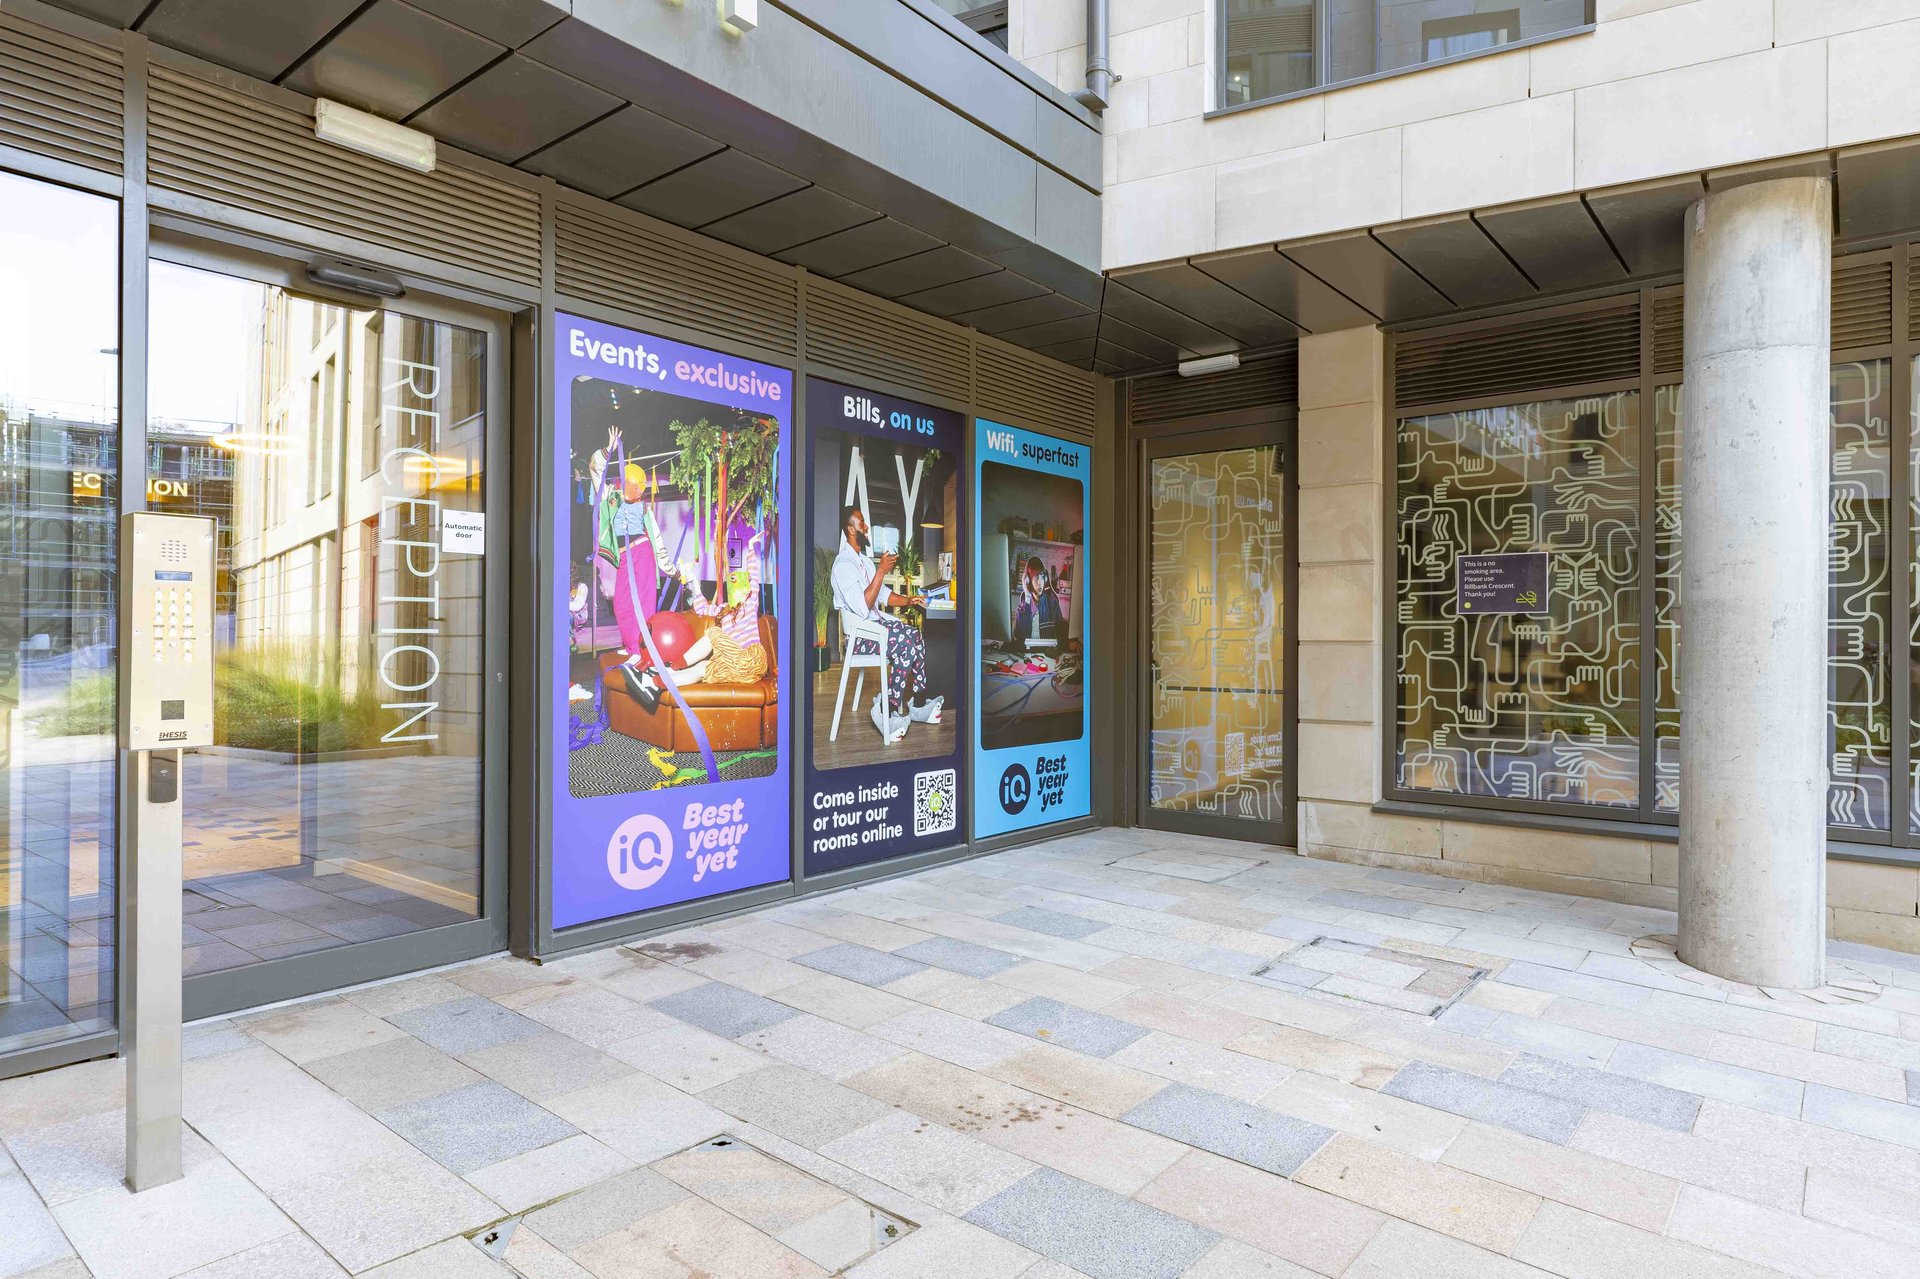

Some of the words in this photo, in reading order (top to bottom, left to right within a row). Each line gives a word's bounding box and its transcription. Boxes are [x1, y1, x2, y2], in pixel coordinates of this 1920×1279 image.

[570, 329, 667, 380] Events,
[674, 360, 781, 401] exclusive
[843, 395, 885, 429] Bills,
[890, 411, 911, 431] on
[916, 417, 935, 436] us
[986, 429, 1018, 458] Wifi,
[1022, 443, 1079, 468] superfast
[445, 522, 483, 532] Automatic
[381, 357, 440, 743] RECEPTION
[1036, 754, 1067, 775] Best
[813, 792, 855, 810] Come
[858, 781, 899, 803] inside
[1037, 773, 1068, 796] year
[1041, 788, 1064, 812] yet
[683, 798, 745, 830] Best
[813, 816, 830, 832] or
[832, 811, 862, 828] tour
[865, 806, 889, 822] our
[685, 823, 749, 859] year
[813, 832, 858, 854] rooms
[861, 822, 903, 844] online
[692, 845, 739, 882] yet
